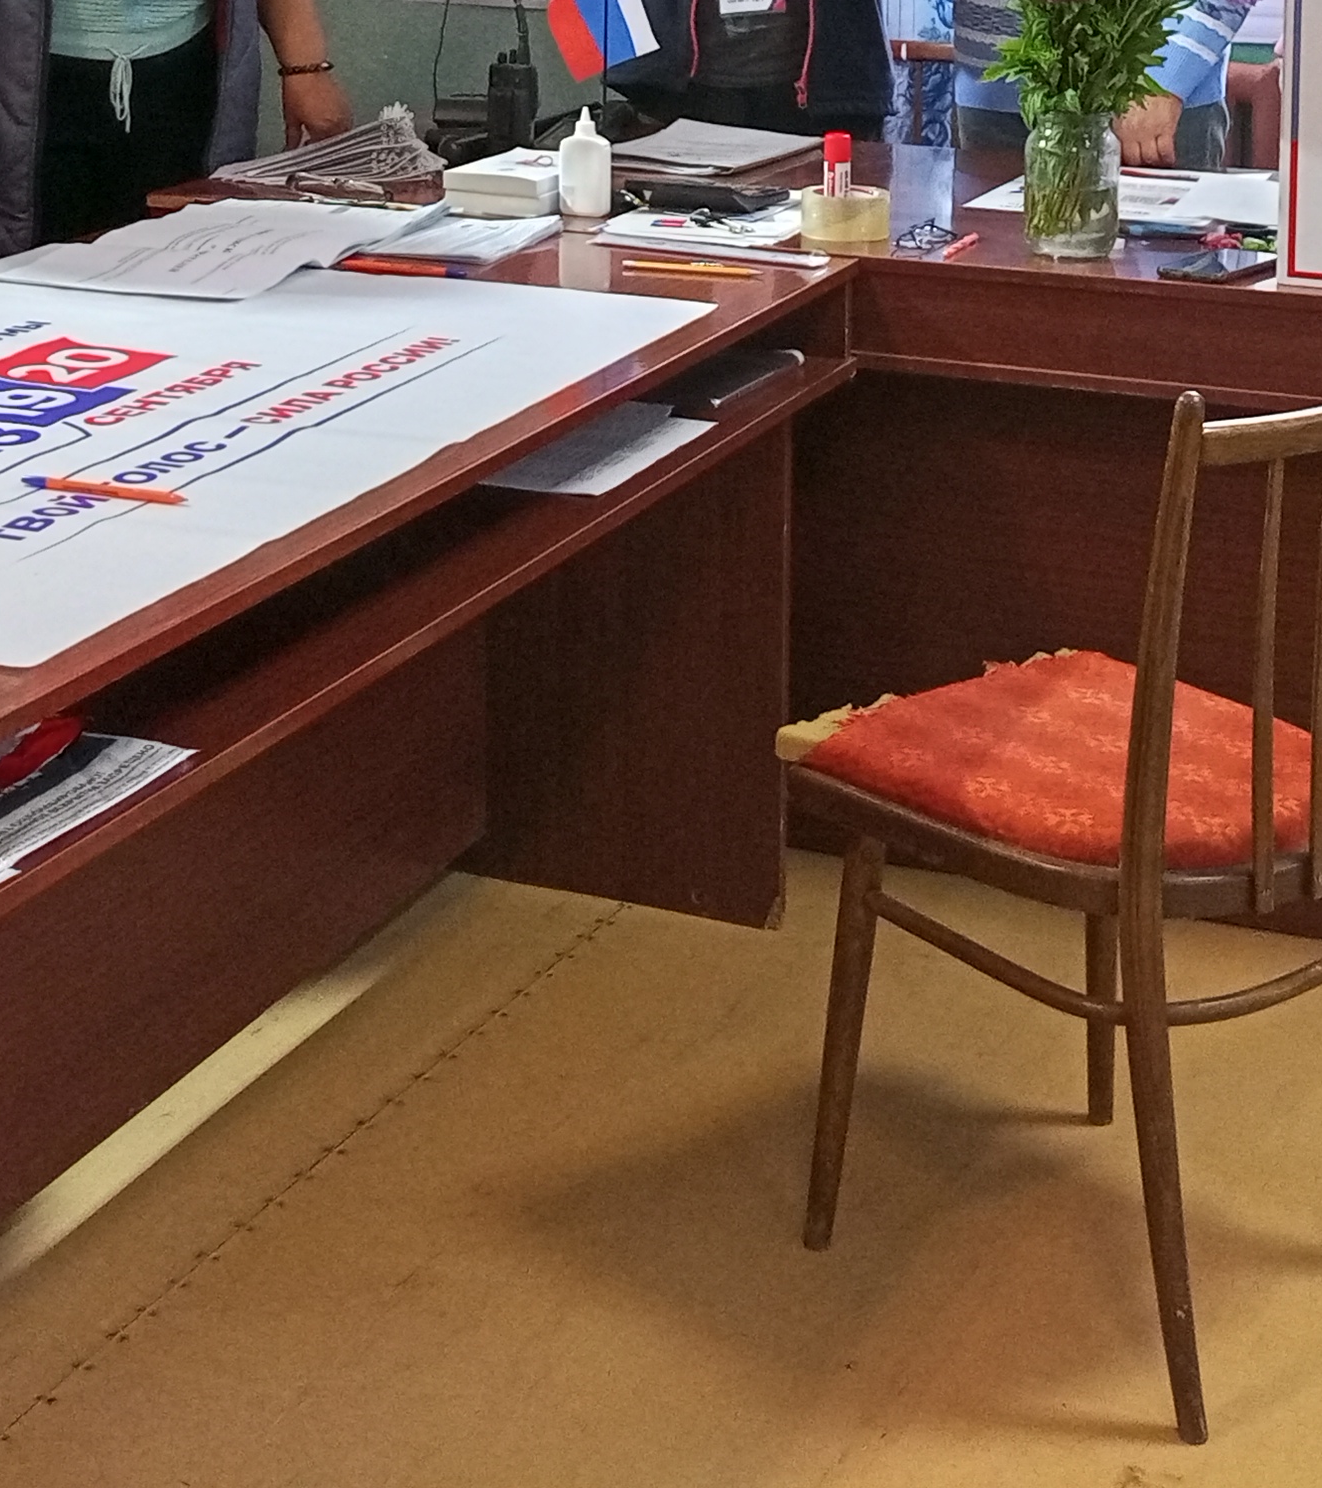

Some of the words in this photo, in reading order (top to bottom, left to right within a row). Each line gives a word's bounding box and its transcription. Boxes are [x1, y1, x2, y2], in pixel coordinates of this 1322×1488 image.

[7, 347, 129, 383] 20
[83, 360, 262, 426] СЕНТЯБРЯ
[100, 440, 228, 485] ОЛОС
[240, 388, 344, 427] СИЛА
[323, 335, 461, 389] РОССИИ!
